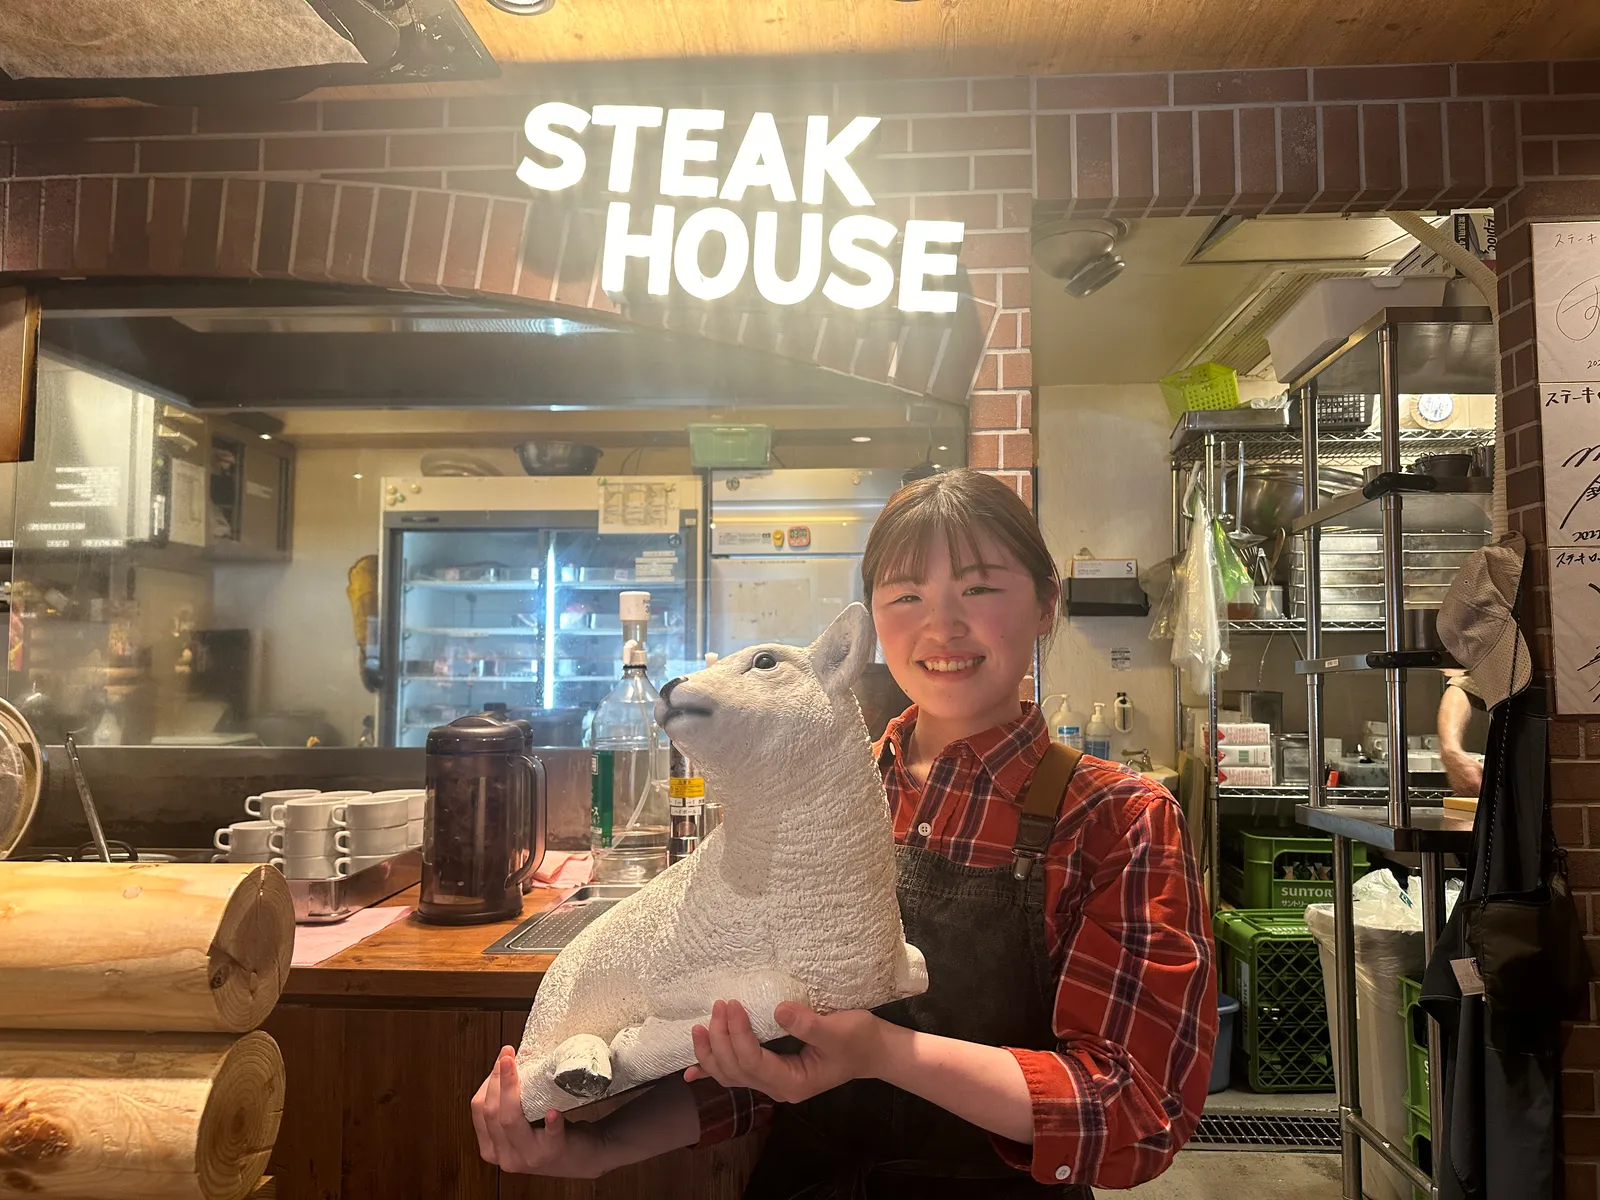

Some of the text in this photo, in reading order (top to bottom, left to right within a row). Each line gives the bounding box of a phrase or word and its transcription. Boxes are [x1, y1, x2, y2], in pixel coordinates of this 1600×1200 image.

[516, 101, 881, 207] STEAK
[1555, 233, 1597, 247] ステーキ
[601, 202, 965, 313] HOUSE
[1545, 387, 1600, 407] ステーキ
[1126, 562, 1133, 572] S
[1281, 887, 1335, 898] SUNTOR
